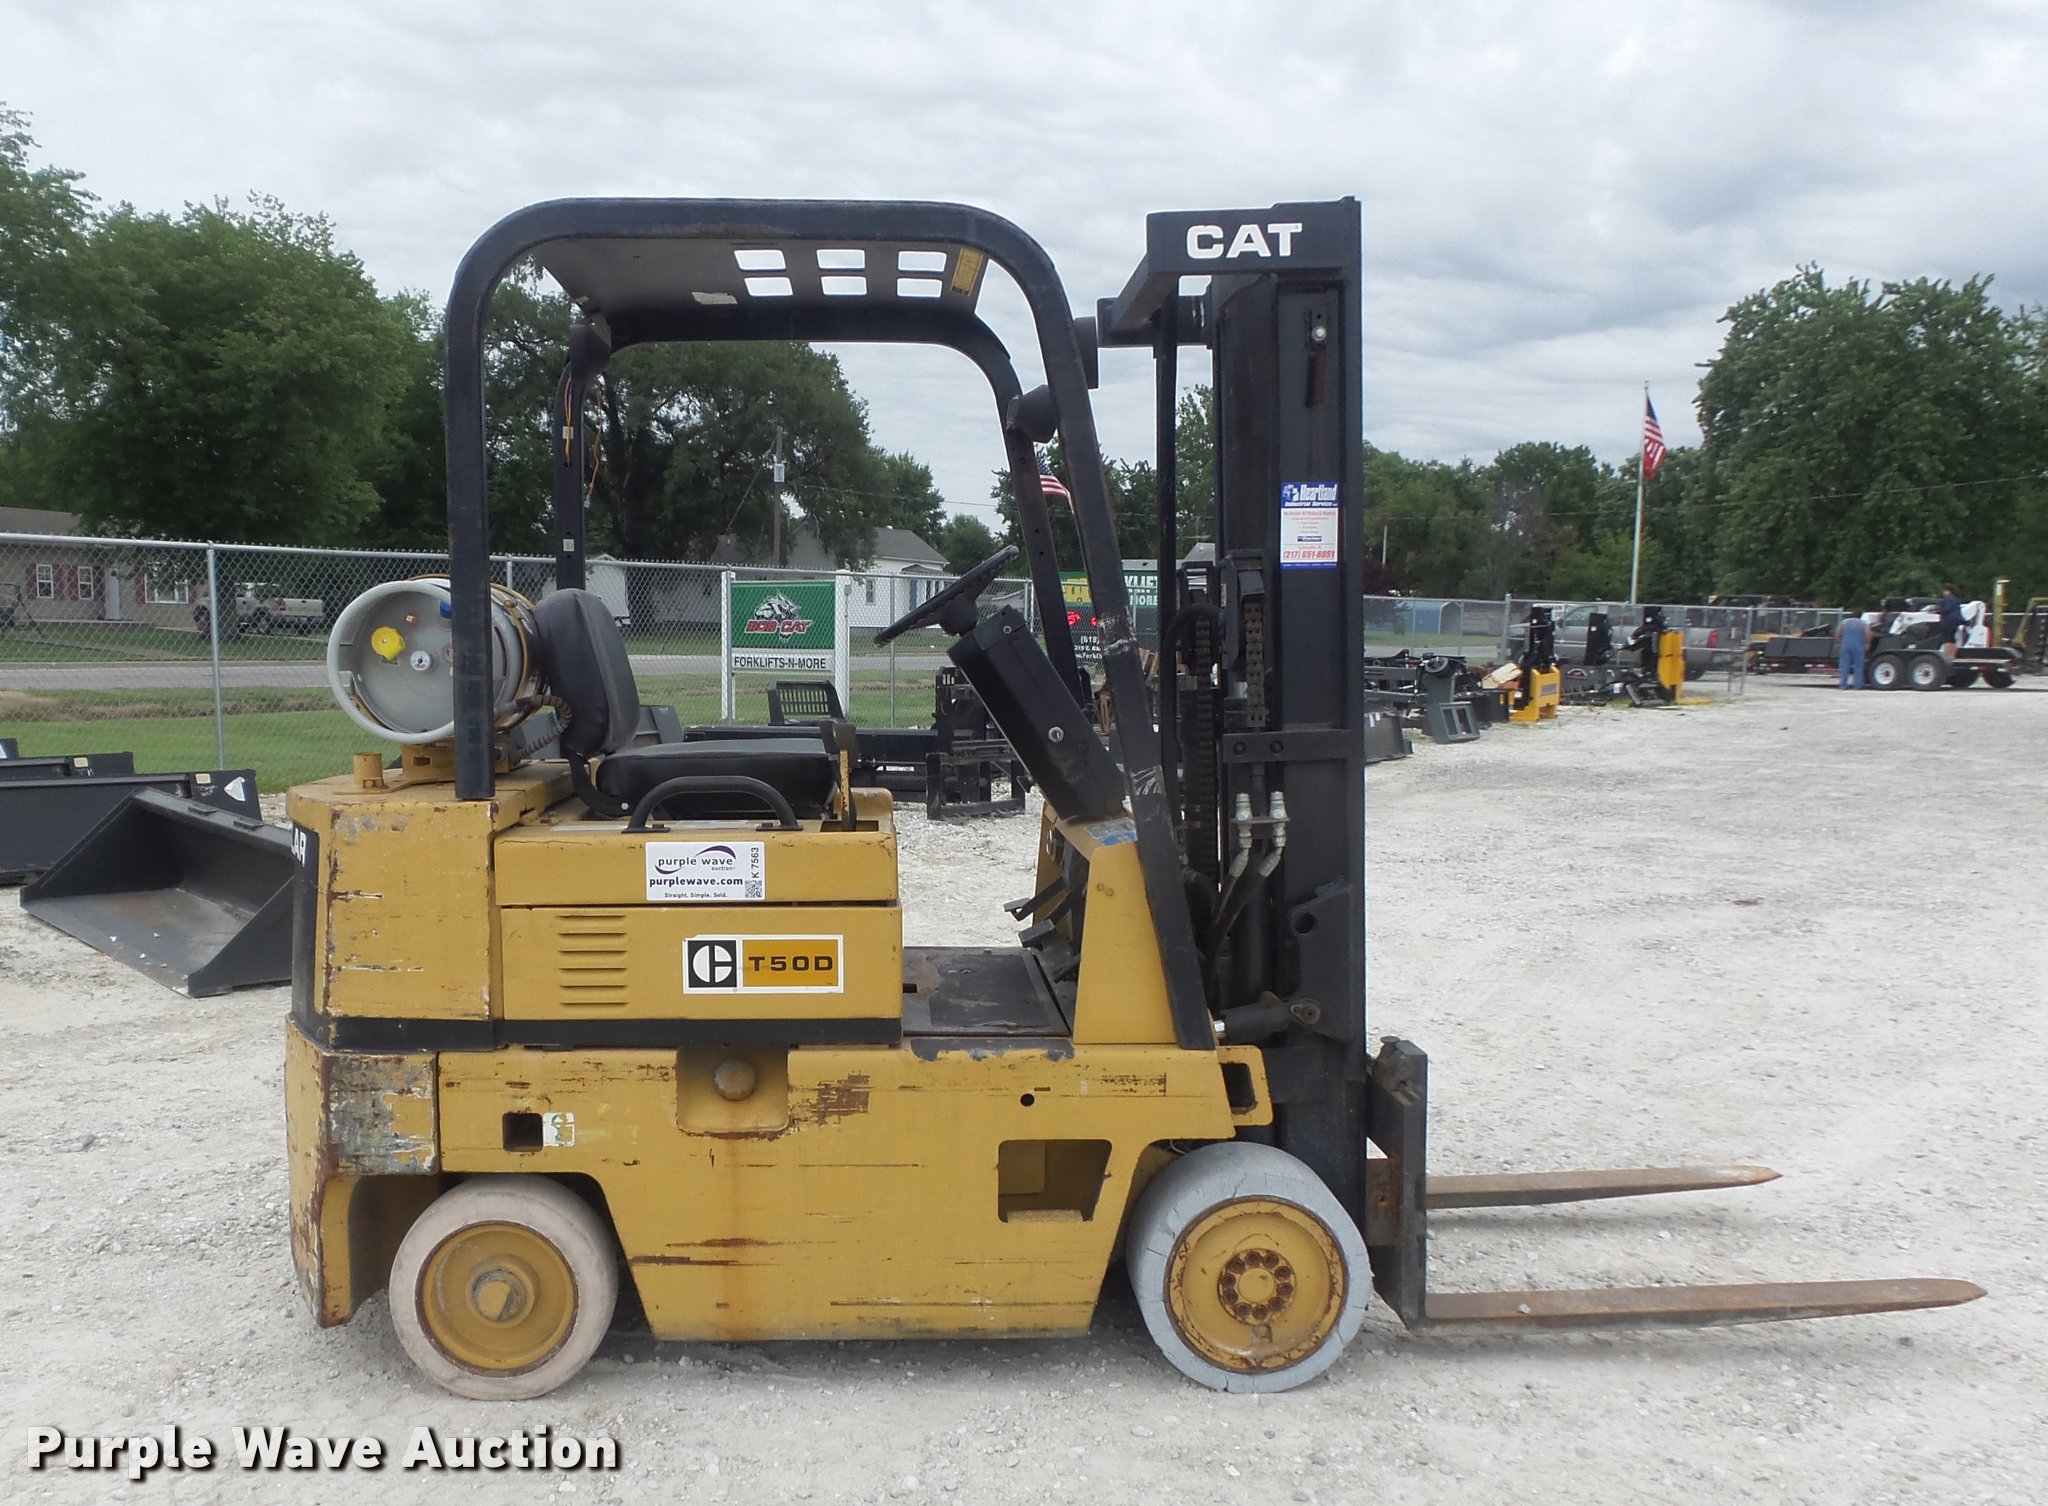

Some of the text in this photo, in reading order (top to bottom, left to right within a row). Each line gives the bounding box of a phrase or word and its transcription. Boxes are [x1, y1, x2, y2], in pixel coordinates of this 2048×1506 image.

[1186, 223, 1303, 259] CAT
[1300, 484, 1338, 501] Heartland
[734, 656, 827, 669] FORKLIFTS-N-MORE
[658, 857, 733, 868] purple wave
[751, 847, 760, 879] K 7563
[649, 876, 743, 888] purplewave.com
[748, 955, 833, 972] T50D
